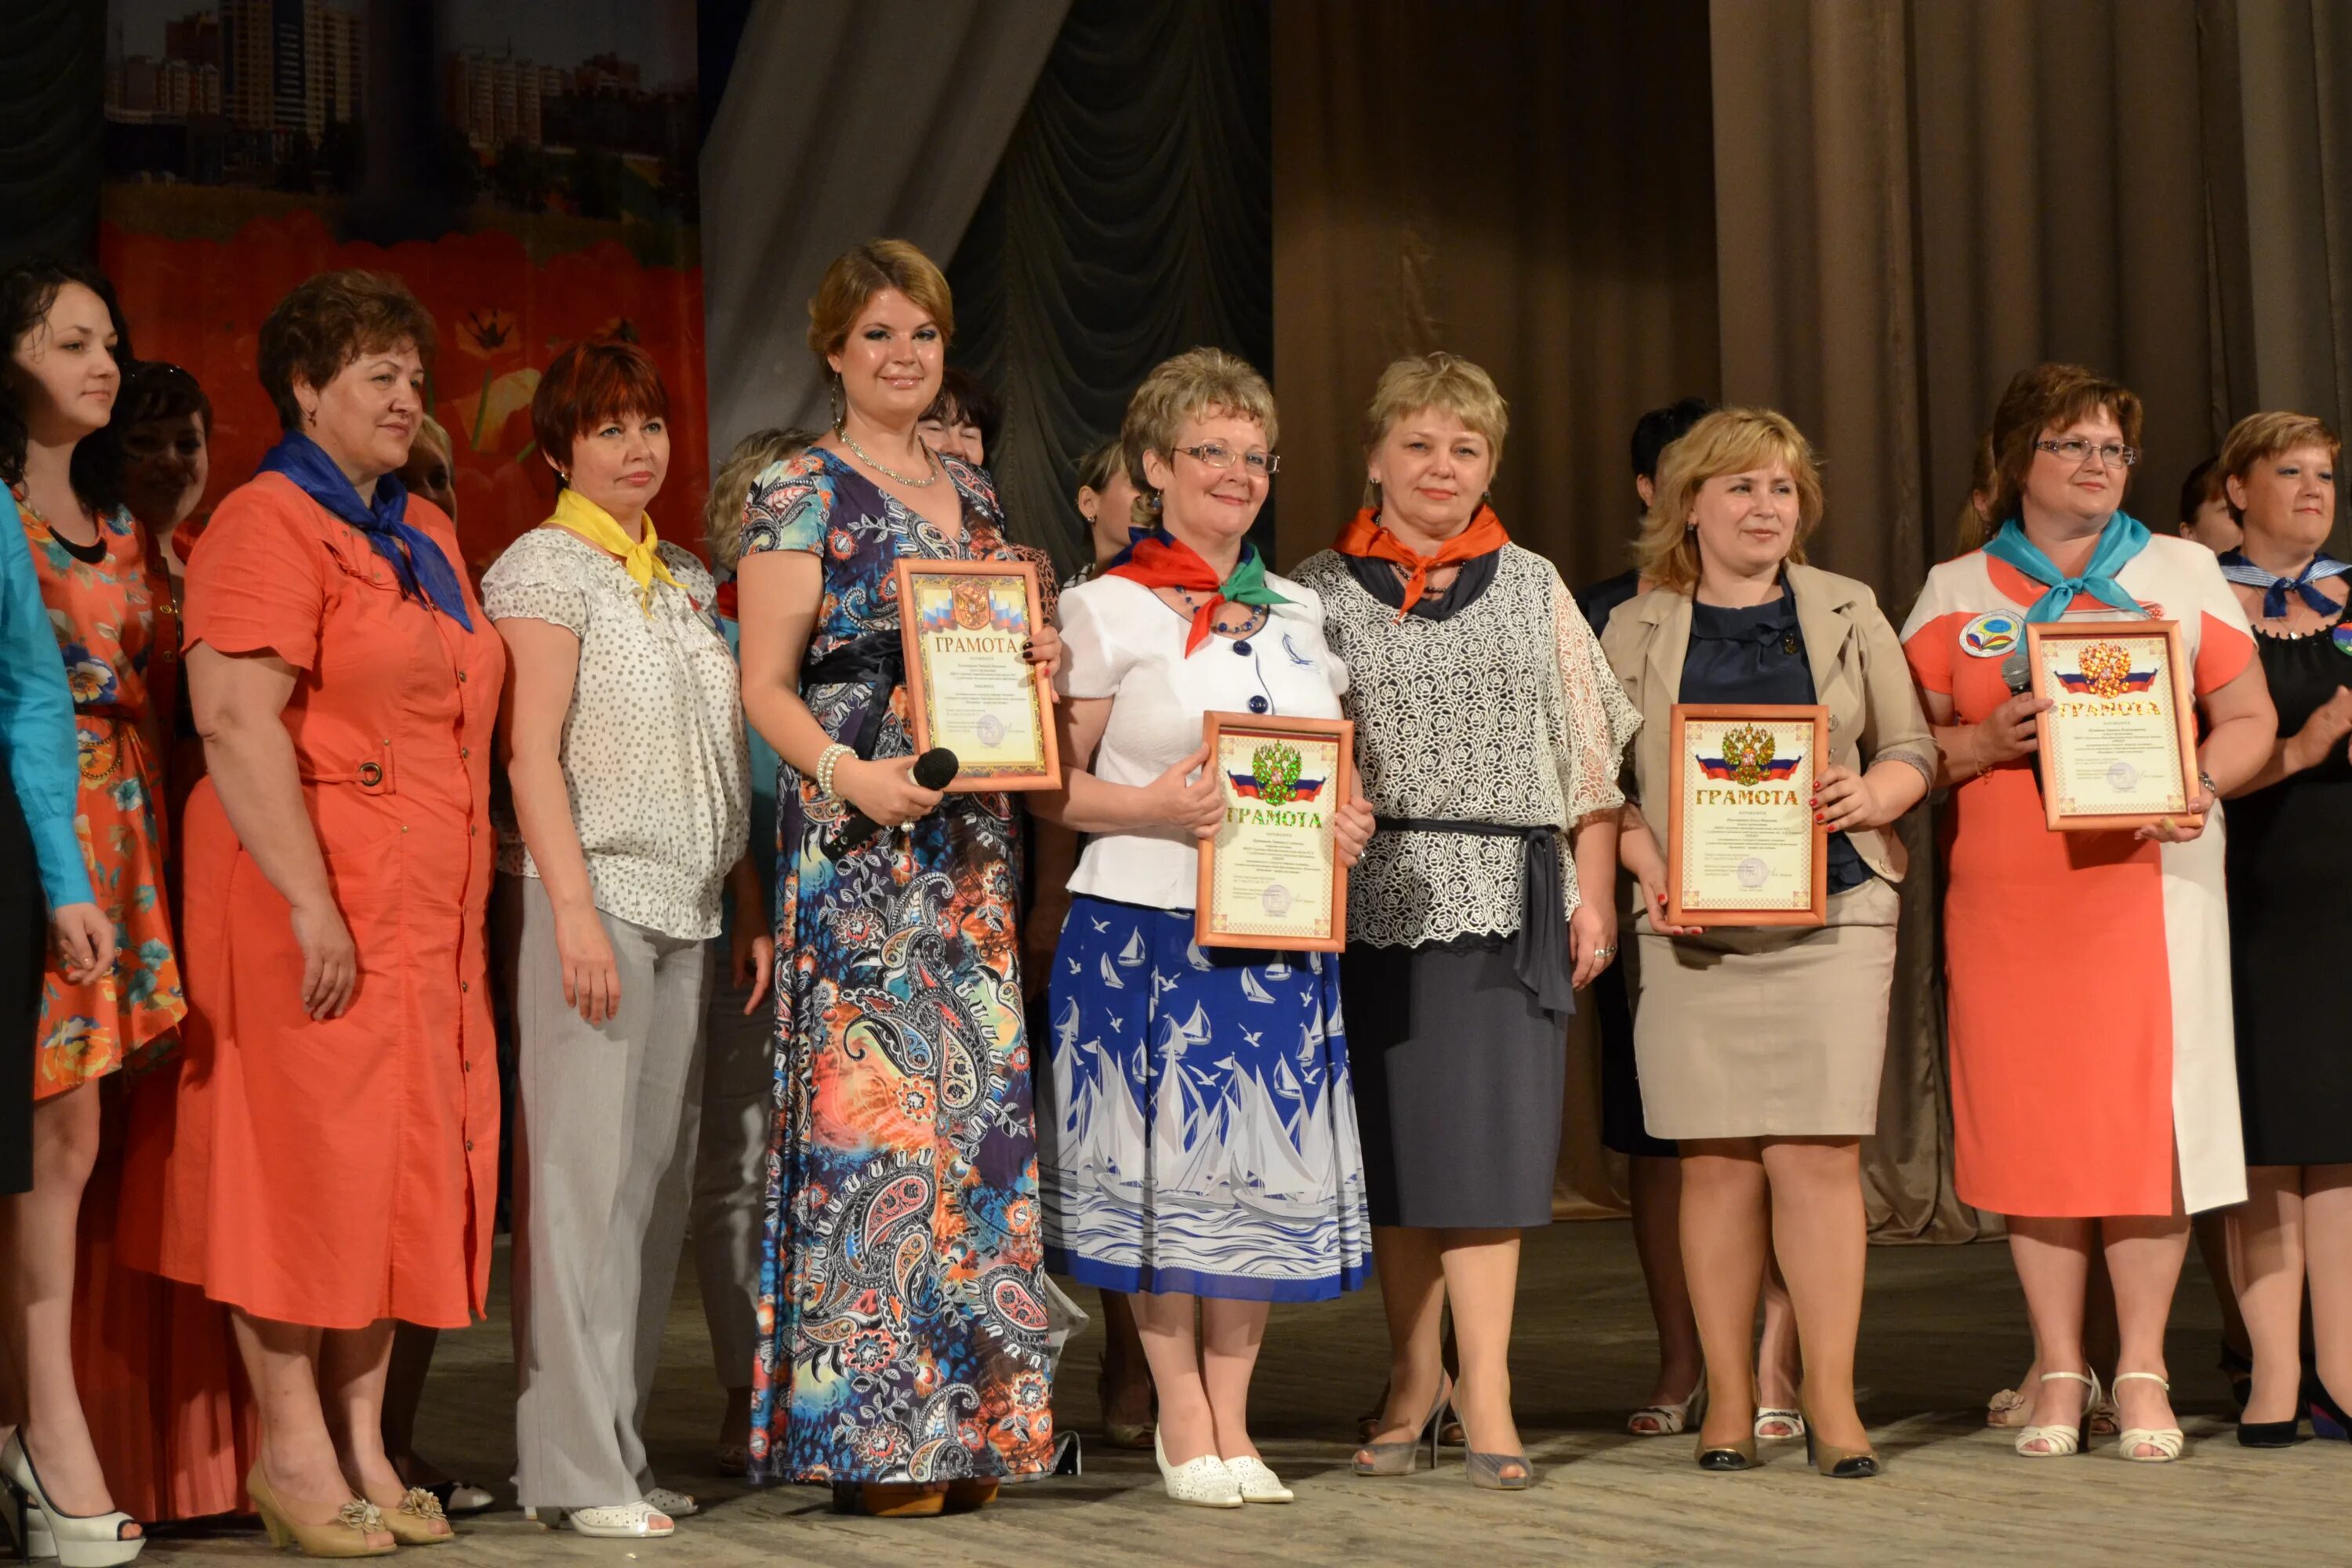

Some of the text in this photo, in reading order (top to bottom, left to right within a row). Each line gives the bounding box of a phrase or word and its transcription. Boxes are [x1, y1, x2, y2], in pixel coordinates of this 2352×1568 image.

[935, 637, 1018, 652] ГРАМОТА
[2060, 702, 2161, 717] ГРАМОТА
[1696, 789, 1798, 805] ГРАМОТА
[1227, 808, 1323, 828] ГРАМОТА
